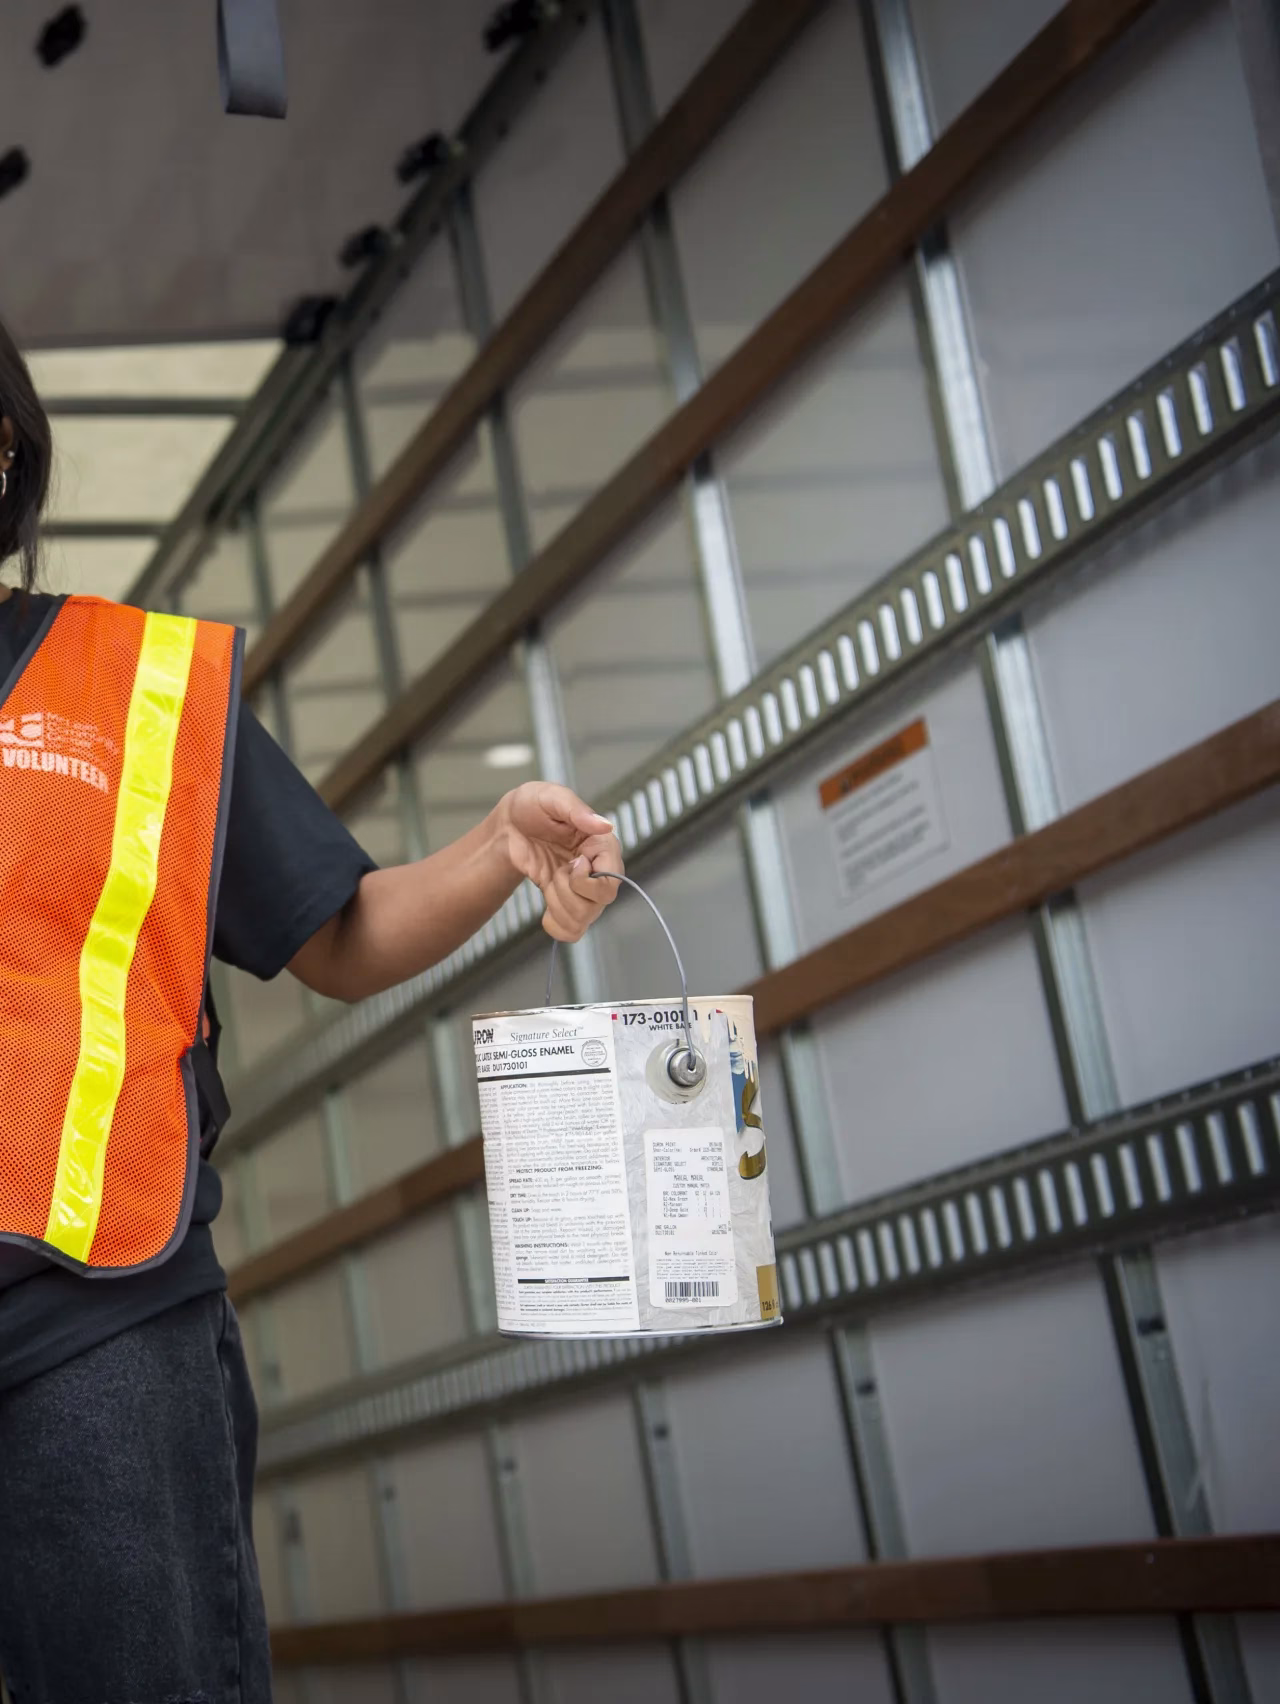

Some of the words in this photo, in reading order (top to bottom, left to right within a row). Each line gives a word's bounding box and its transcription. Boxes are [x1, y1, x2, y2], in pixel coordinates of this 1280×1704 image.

[1, 747, 109, 795] VOLUNTEER
[648, 1022, 674, 1031] WHITE
[675, 1022, 693, 1030] BAE
[510, 1030, 549, 1045] Signature
[493, 1047, 537, 1061] SEMI-GLOSS
[539, 1045, 575, 1057] ENAMEL
[481, 1064, 491, 1073] BASE
[492, 1061, 528, 1073] DU1730101
[673, 1174, 689, 1182] MANUAL
[690, 1174, 706, 1182] MANUAL
